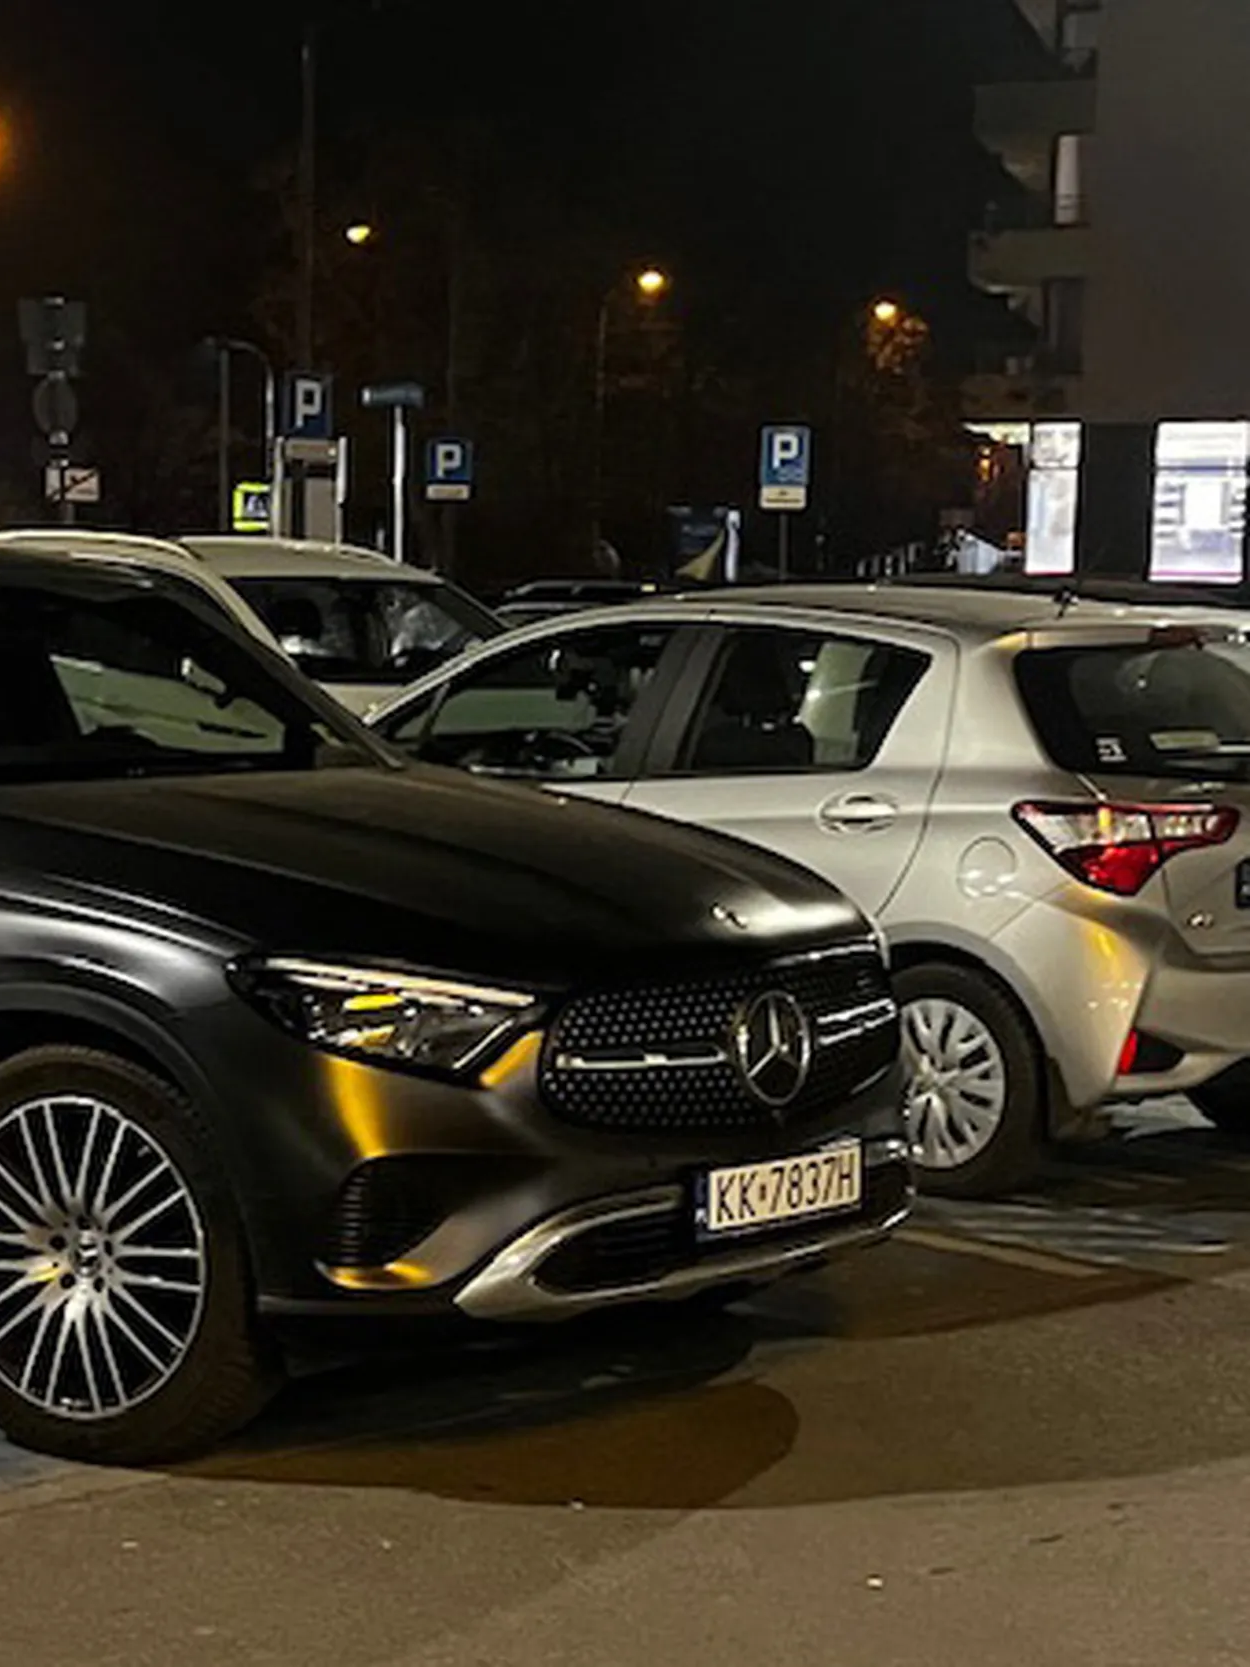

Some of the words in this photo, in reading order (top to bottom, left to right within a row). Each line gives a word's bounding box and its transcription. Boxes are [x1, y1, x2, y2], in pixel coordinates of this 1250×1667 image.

[295, 380, 322, 428] P
[436, 444, 462, 479] P
[772, 433, 799, 468] P
[716, 1172, 757, 1223] KK
